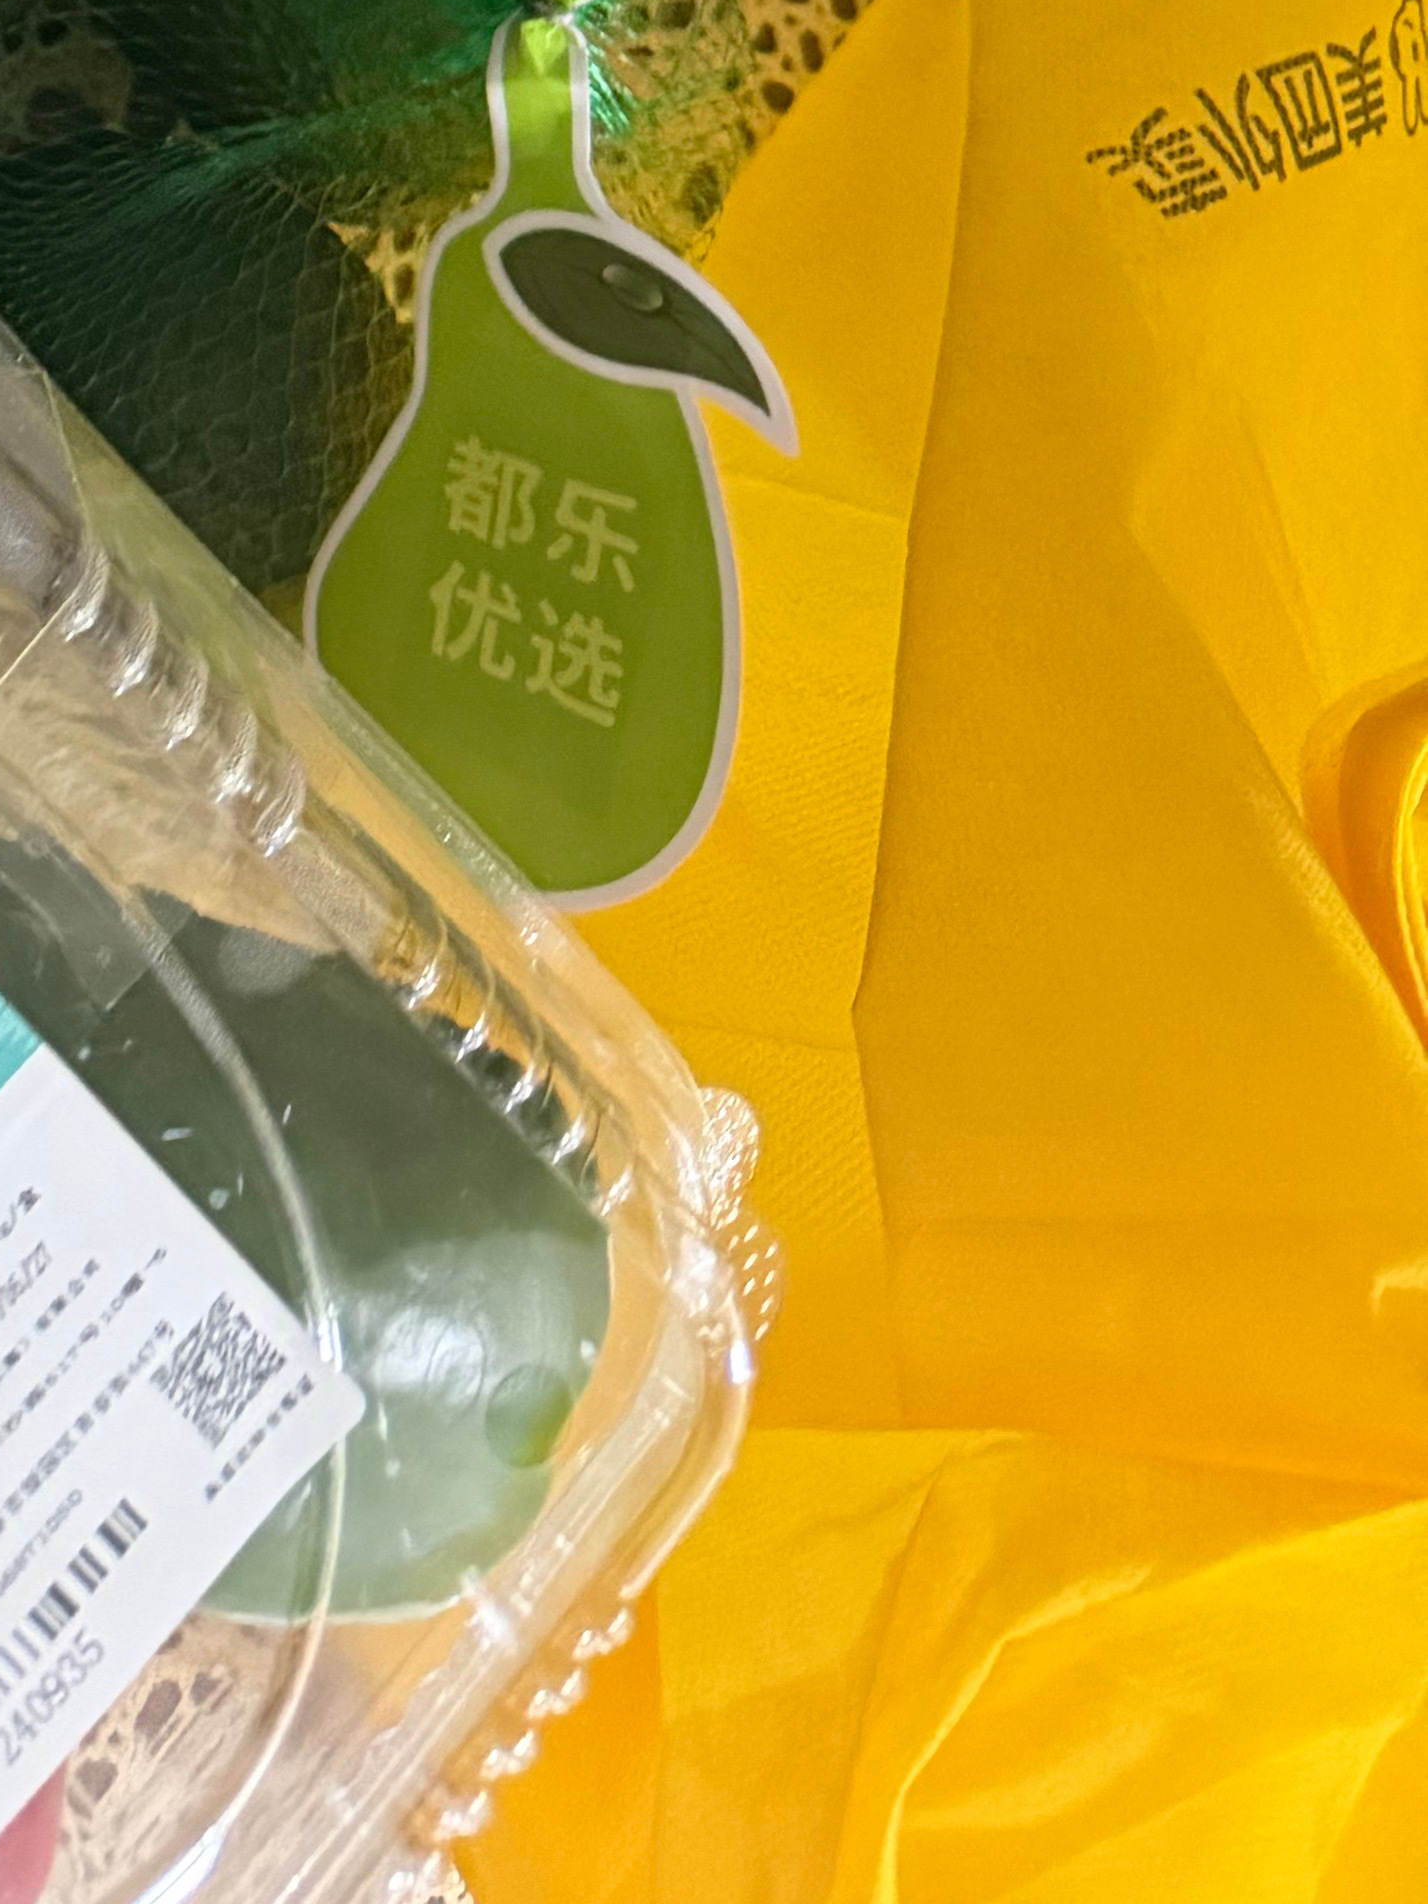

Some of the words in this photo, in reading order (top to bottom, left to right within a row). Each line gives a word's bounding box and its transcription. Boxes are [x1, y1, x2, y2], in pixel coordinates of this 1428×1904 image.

[1085, 25, 1383, 218] 美团外卖
[444, 434, 641, 594] 都乐
[427, 559, 626, 727] 优选
